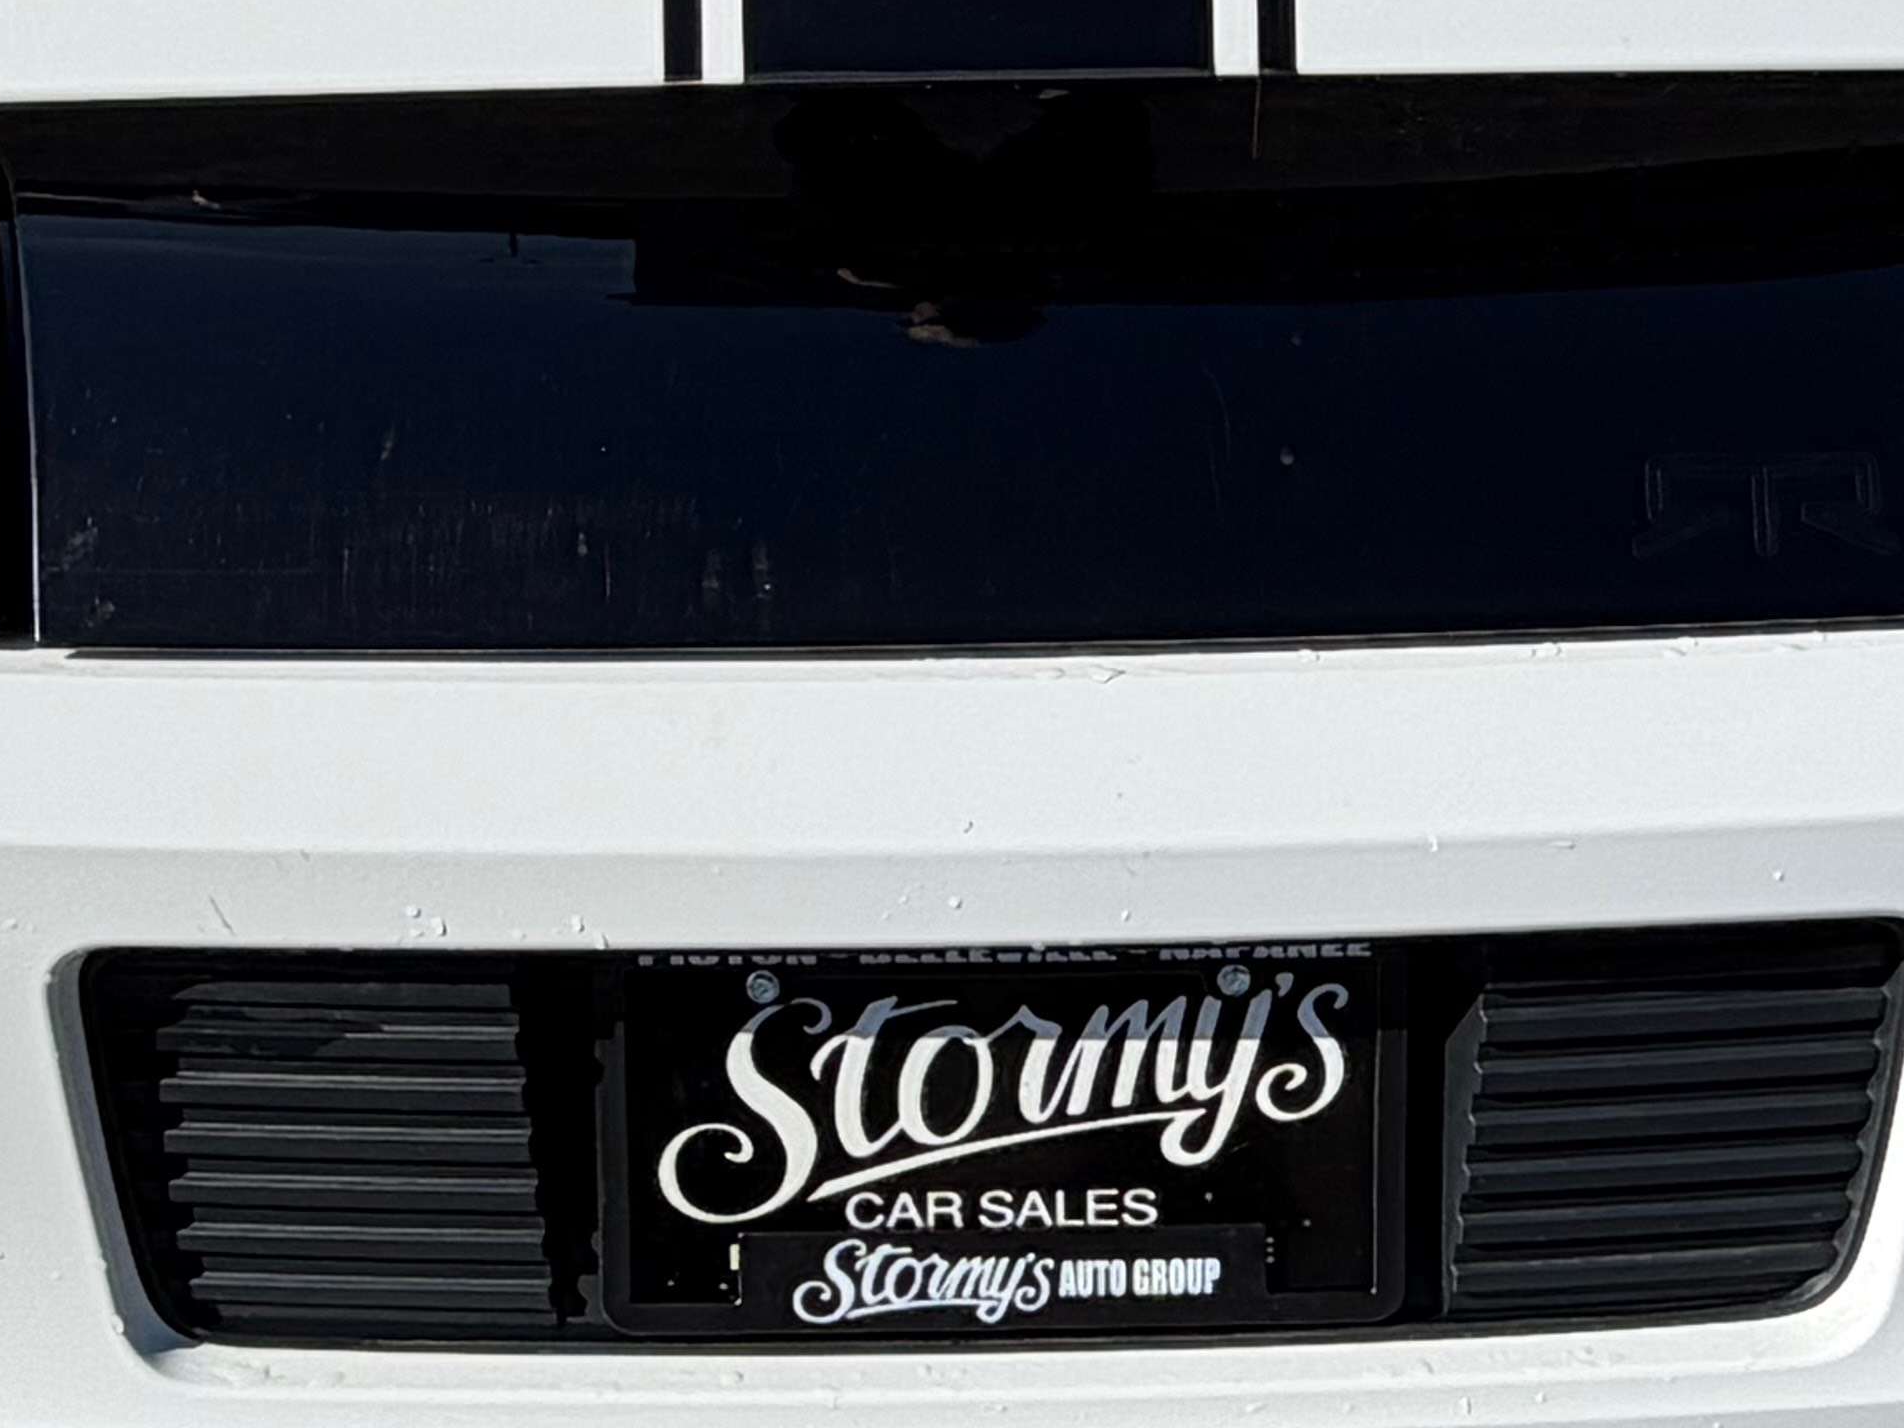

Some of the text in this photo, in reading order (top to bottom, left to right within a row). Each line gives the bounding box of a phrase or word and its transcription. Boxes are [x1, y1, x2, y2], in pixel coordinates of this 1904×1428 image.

[657, 971, 1350, 1226] Stormy's
[844, 1188, 1160, 1230] CAR SALES
[790, 1237, 1222, 1325] Stormy's AUTO GROUP
